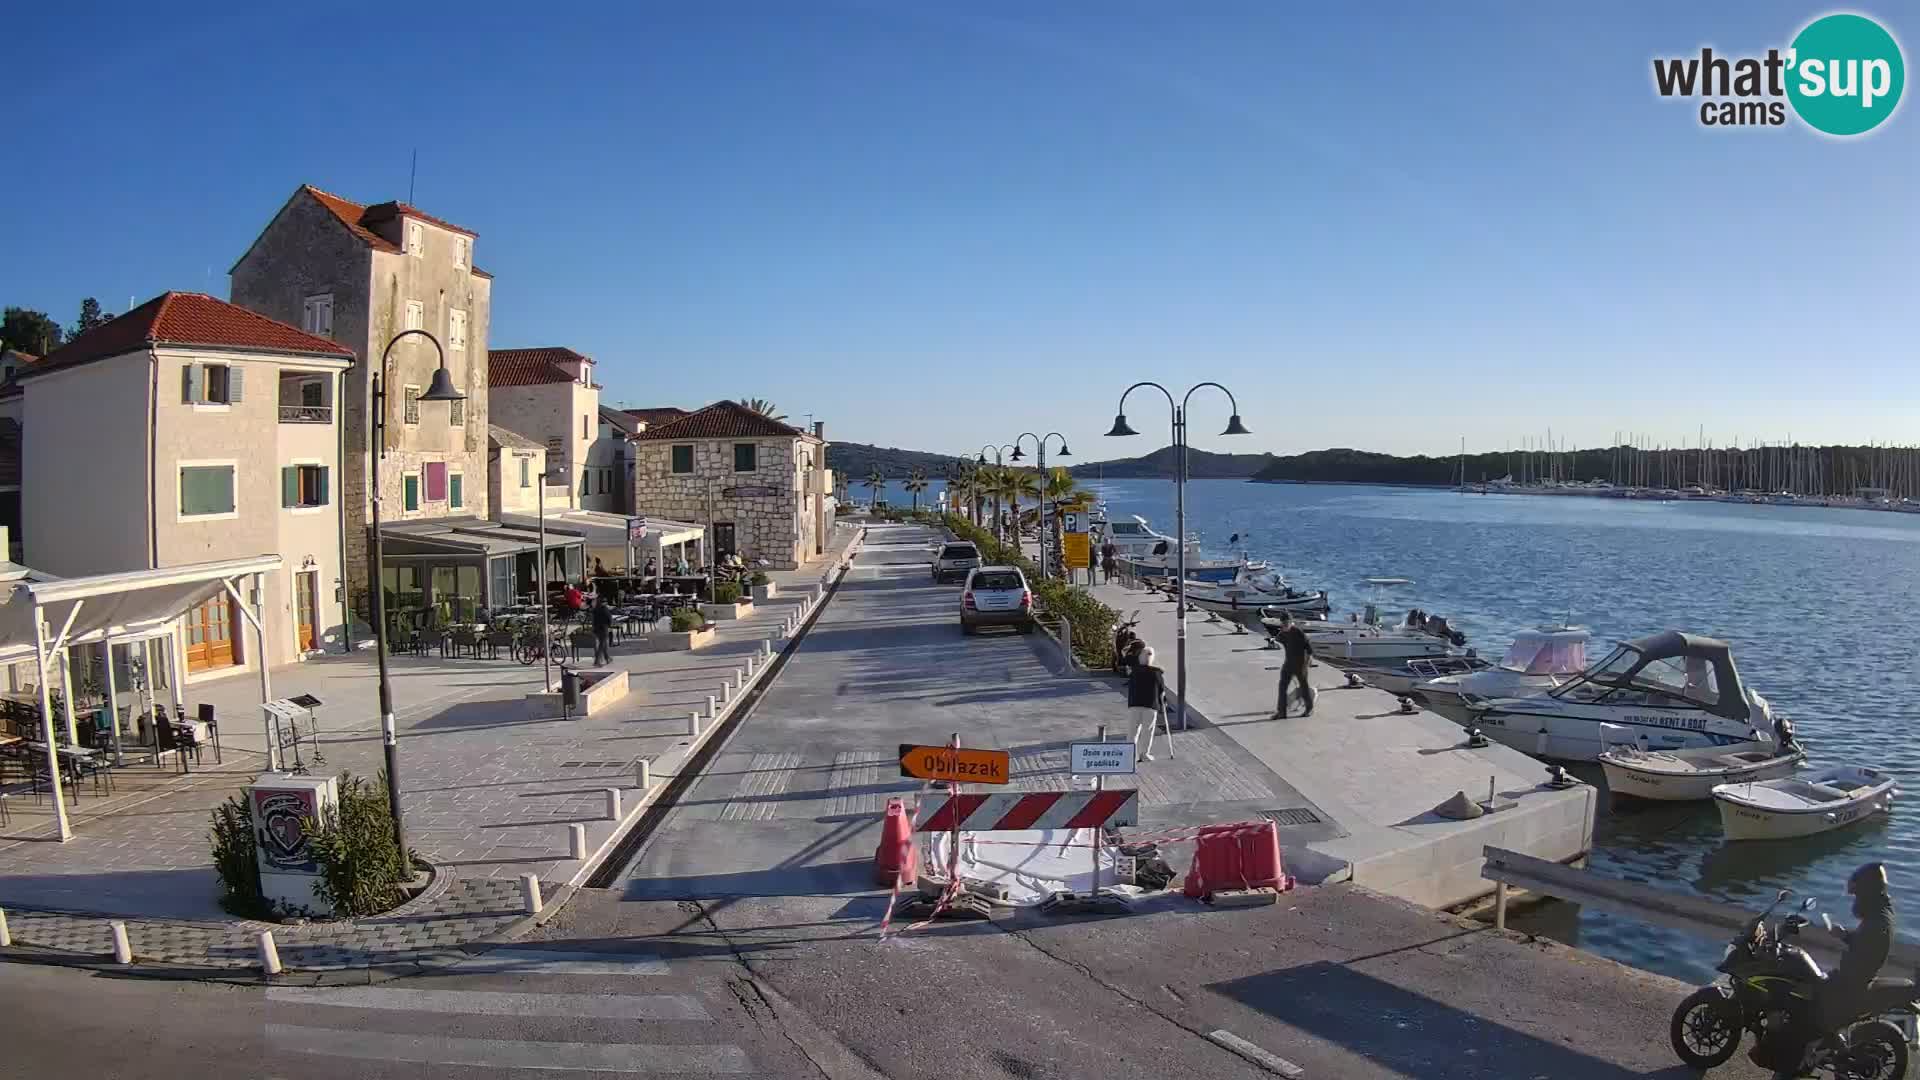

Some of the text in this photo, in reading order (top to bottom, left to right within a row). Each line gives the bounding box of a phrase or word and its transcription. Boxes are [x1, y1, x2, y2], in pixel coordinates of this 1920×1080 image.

[1065, 514, 1076, 531] P
[1687, 718, 1708, 730] BOAT
[923, 754, 1000, 777] Obilazak
